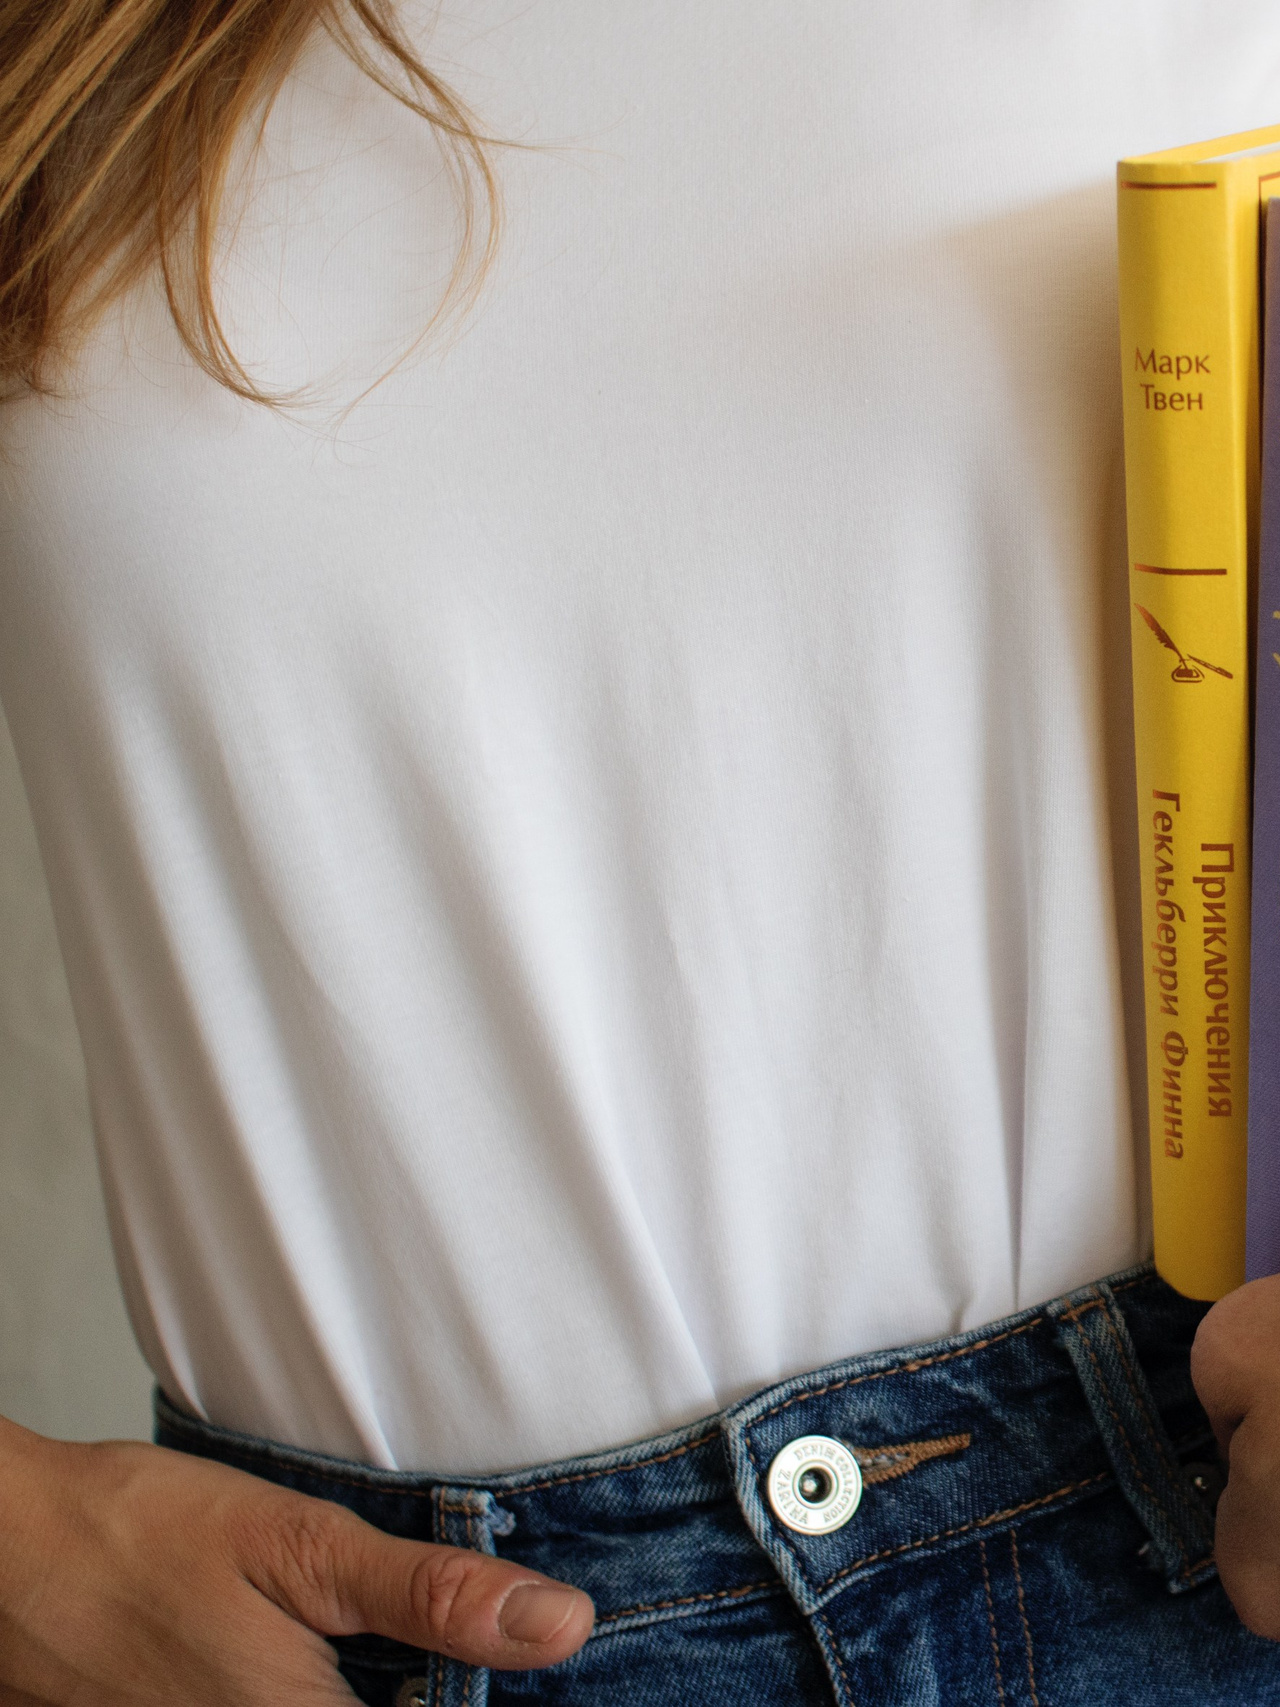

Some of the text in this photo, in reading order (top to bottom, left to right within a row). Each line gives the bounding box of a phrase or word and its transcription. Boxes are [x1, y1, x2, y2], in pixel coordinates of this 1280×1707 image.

[1133, 347, 1211, 380] Марк
[1140, 383, 1204, 412] Твен
[1152, 788, 1189, 1160] Гекльберри Финна
[1193, 842, 1235, 1117] Приключения
[793, 1444, 854, 1523] DENIM COLLECTION
